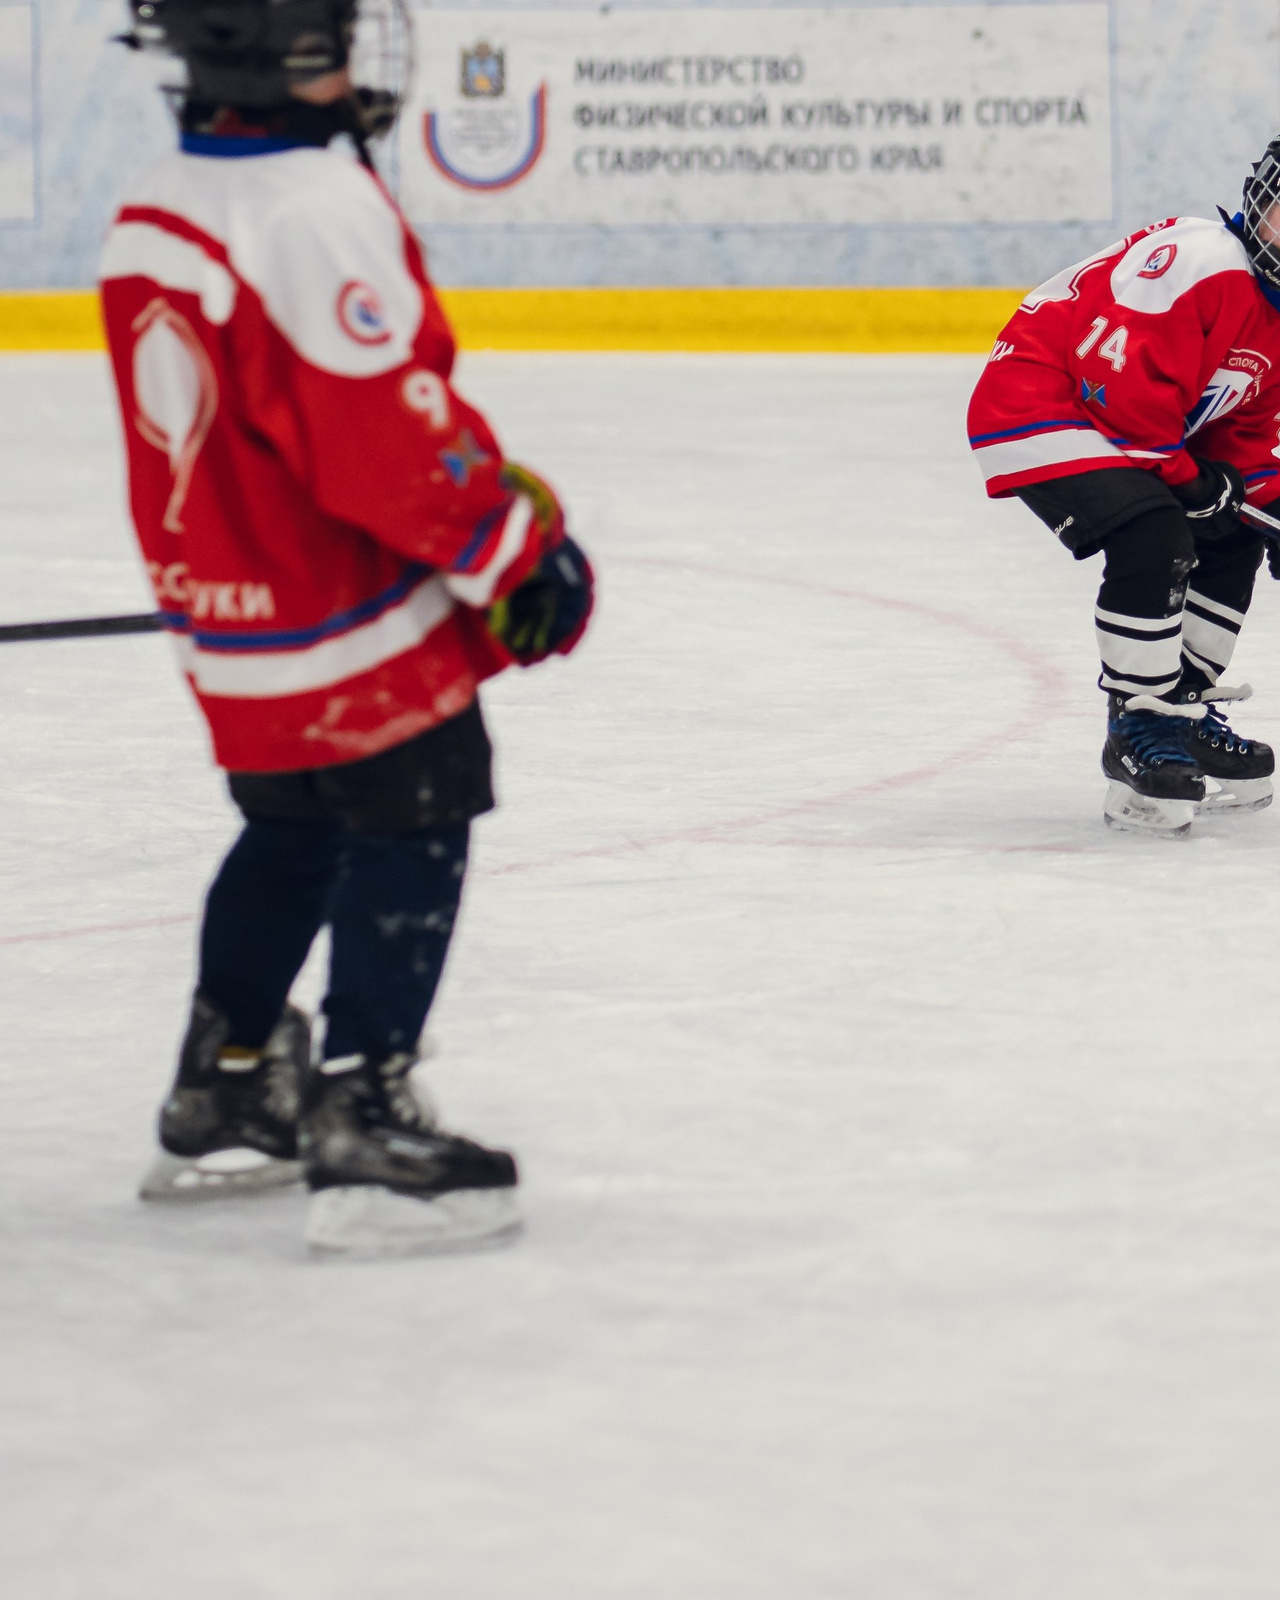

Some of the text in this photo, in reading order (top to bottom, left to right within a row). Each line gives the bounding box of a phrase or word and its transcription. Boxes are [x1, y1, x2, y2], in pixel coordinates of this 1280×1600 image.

[574, 56, 805, 85] МИНИСТЕРСТВО
[574, 95, 1088, 129] ФИЗИЧЕСКОЙ КУЛЬТУРЫ И СПОРТА
[574, 144, 942, 176] СТАВРОПОЛЬСКОГО КРАЯ
[402, 368, 449, 431] 9
